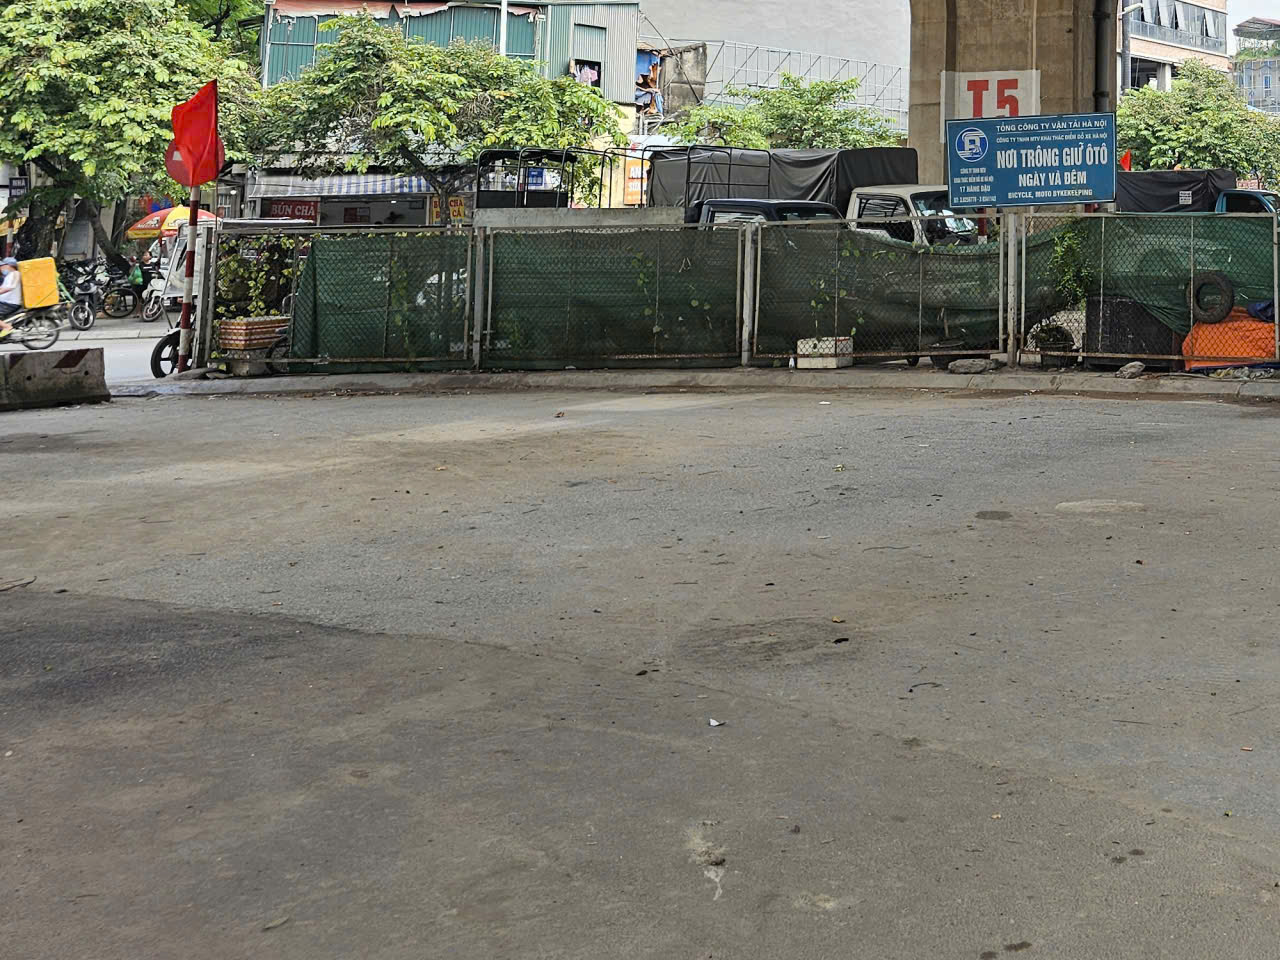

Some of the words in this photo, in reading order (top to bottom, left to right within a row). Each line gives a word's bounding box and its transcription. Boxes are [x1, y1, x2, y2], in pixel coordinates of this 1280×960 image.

[966, 78, 1020, 119] T5
[996, 121, 1016, 132] TỔNG
[1018, 122, 1039, 131] CÔNG
[1052, 120, 1067, 131] VẬN
[1082, 119, 1092, 128] HÀ
[1094, 118, 1107, 129] NỘI
[996, 148, 1017, 169] NƠI
[1020, 145, 1059, 168] TRÔNG
[1063, 142, 1084, 166] GIỮ
[1085, 142, 1108, 165] ÔTÔ
[1018, 171, 1046, 187] NGÀY
[1049, 170, 1061, 186] VÀ
[1064, 169, 1087, 185] ĐÊM
[1008, 191, 1034, 199] BICYCLE,
[1035, 190, 1051, 198] MOTO
[271, 202, 293, 215] BÚN
[295, 202, 316, 216] CHẢ
